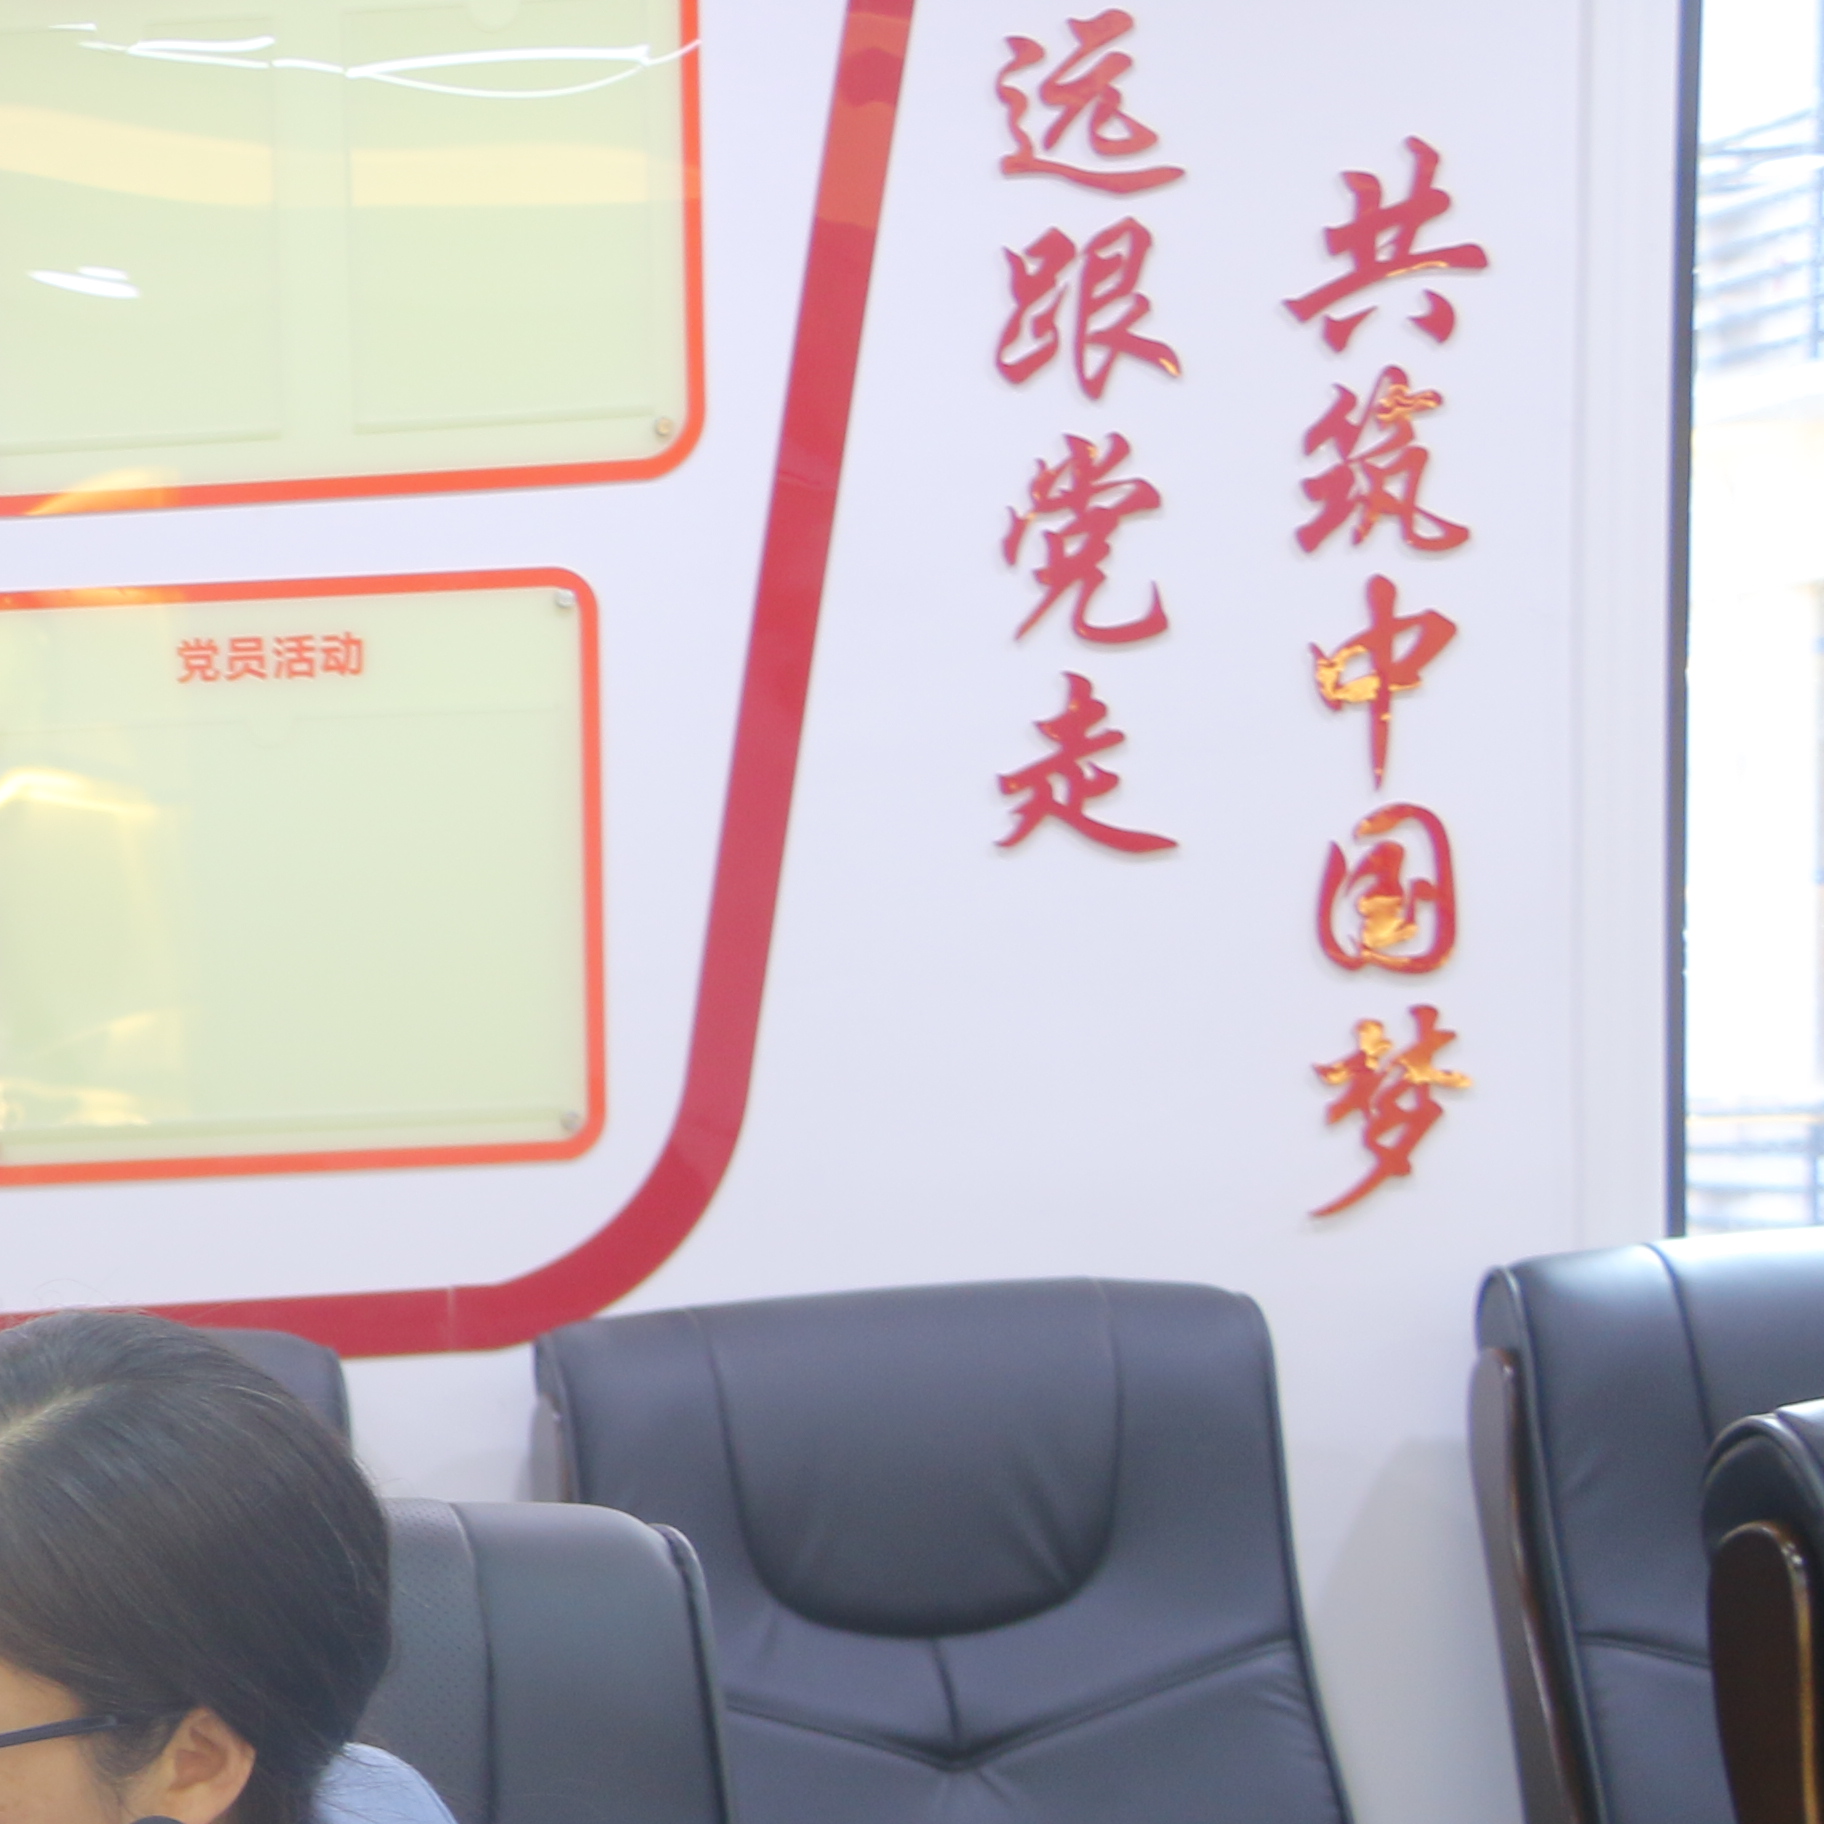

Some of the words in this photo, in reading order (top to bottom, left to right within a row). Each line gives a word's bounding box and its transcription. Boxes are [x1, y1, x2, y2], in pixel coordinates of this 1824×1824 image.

[176, 631, 364, 683] 党员活动
[993, 7, 1185, 858] 远跟党走
[1280, 135, 1492, 1221] 共筑中国梦
